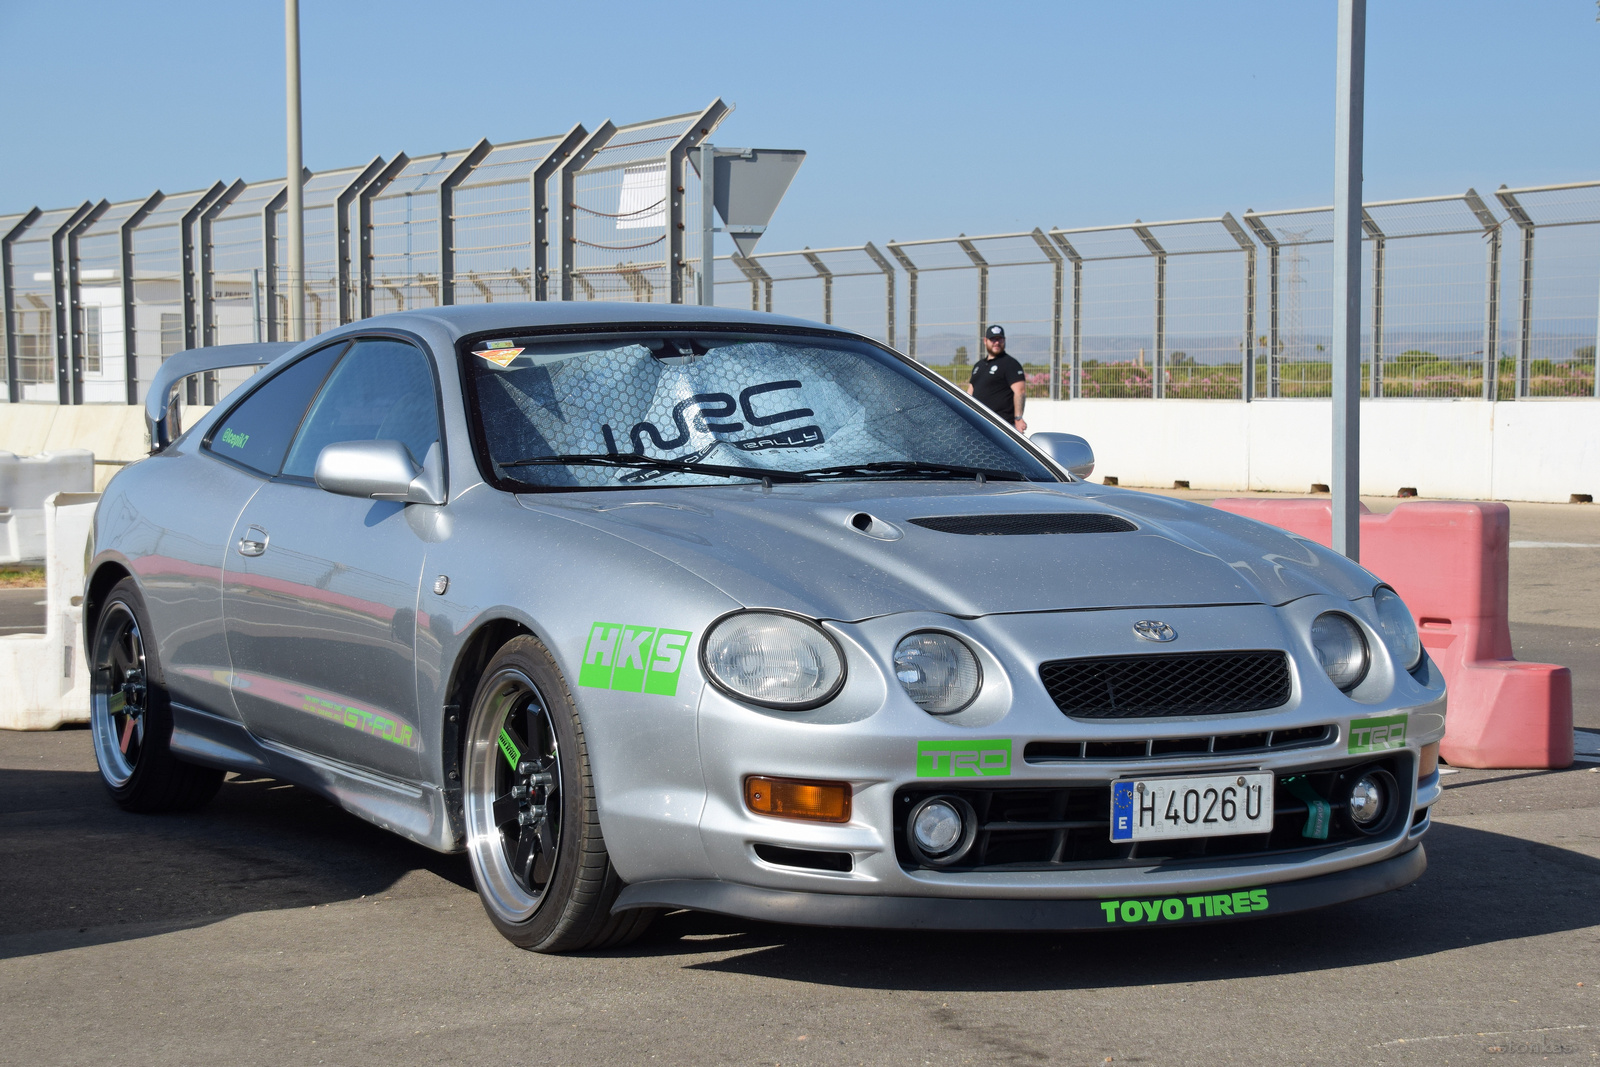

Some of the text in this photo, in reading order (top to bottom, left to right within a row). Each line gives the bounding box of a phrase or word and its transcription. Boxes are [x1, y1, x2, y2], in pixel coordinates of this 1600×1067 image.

[743, 431, 818, 449] RALLY
[585, 626, 688, 673] HKS
[1139, 785, 1261, 827] H 4026 U
[1118, 817, 1128, 830] E
[1100, 889, 1269, 923] TOYO TIRES
